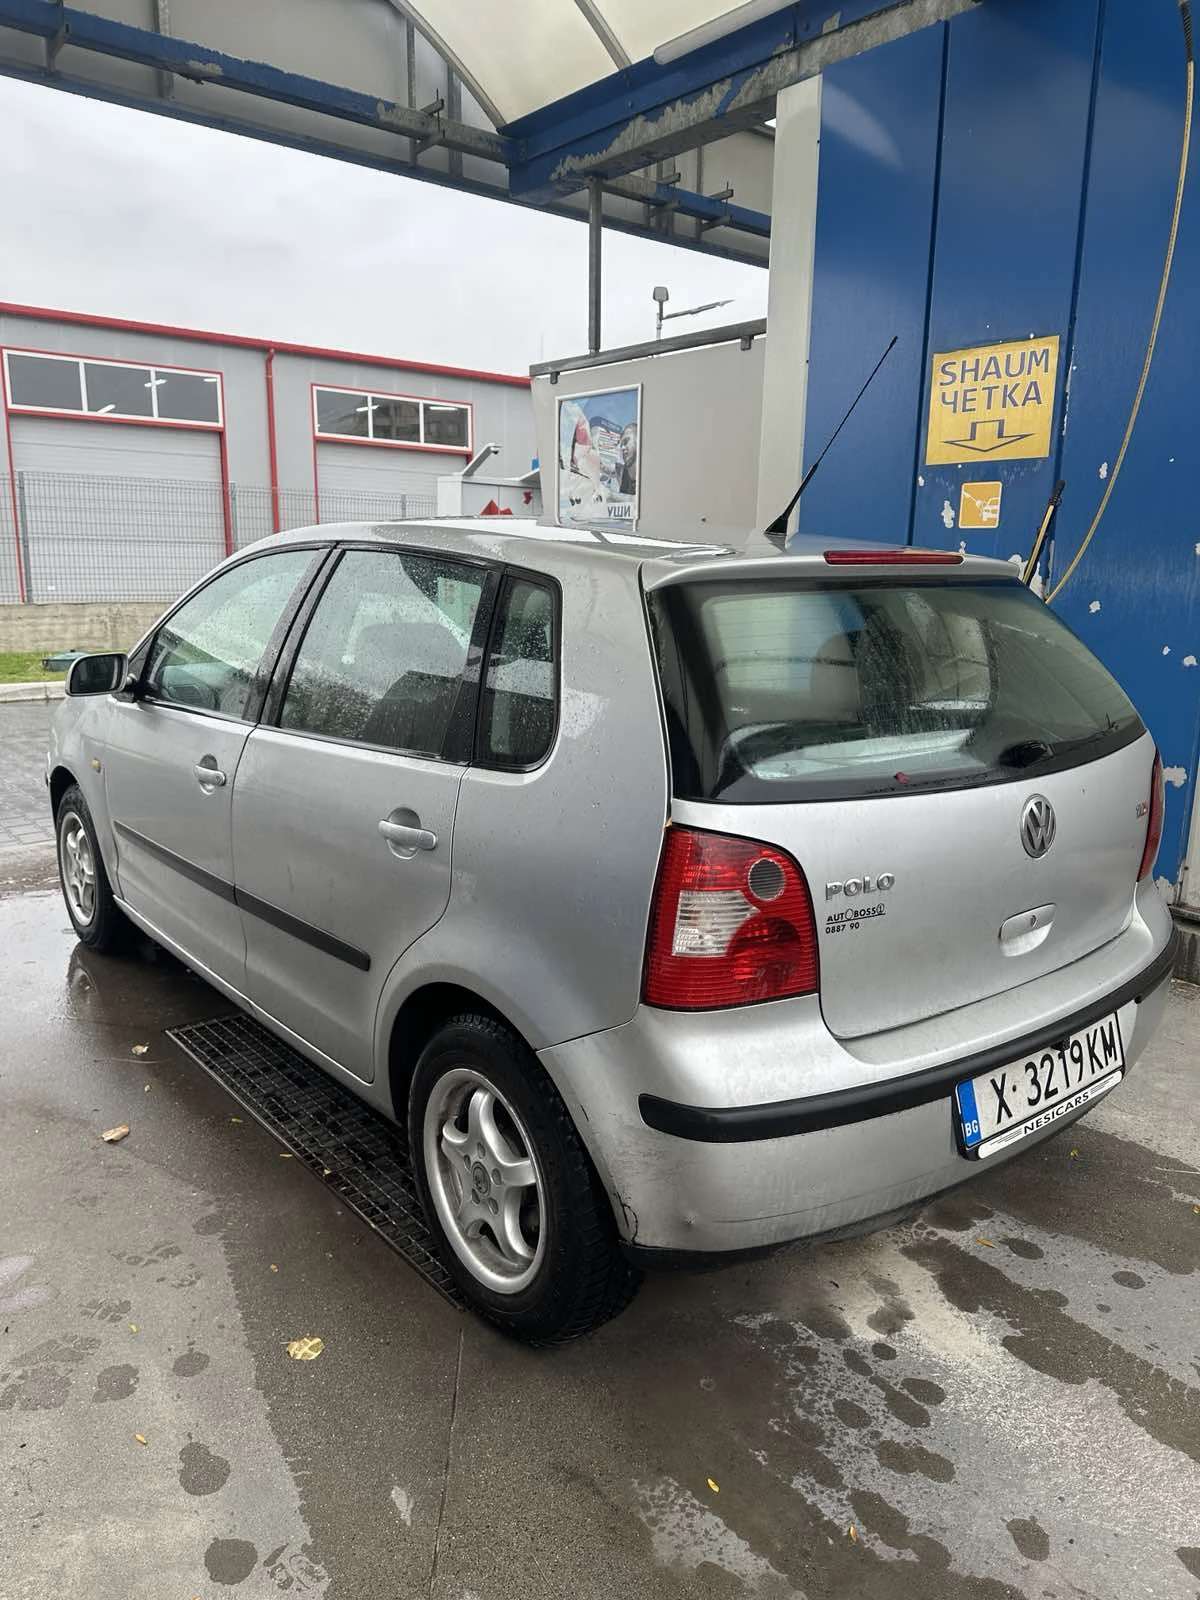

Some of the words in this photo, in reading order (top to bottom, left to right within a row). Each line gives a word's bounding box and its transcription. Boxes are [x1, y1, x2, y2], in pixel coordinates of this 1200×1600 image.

[939, 348, 1050, 387] SHAUM
[940, 380, 1043, 414] ЧЕТКА
[825, 872, 895, 901] POLO
[849, 922, 860, 930] 90
[964, 1119, 979, 1137] BG
[1023, 1091, 1090, 1135] NESICARS
